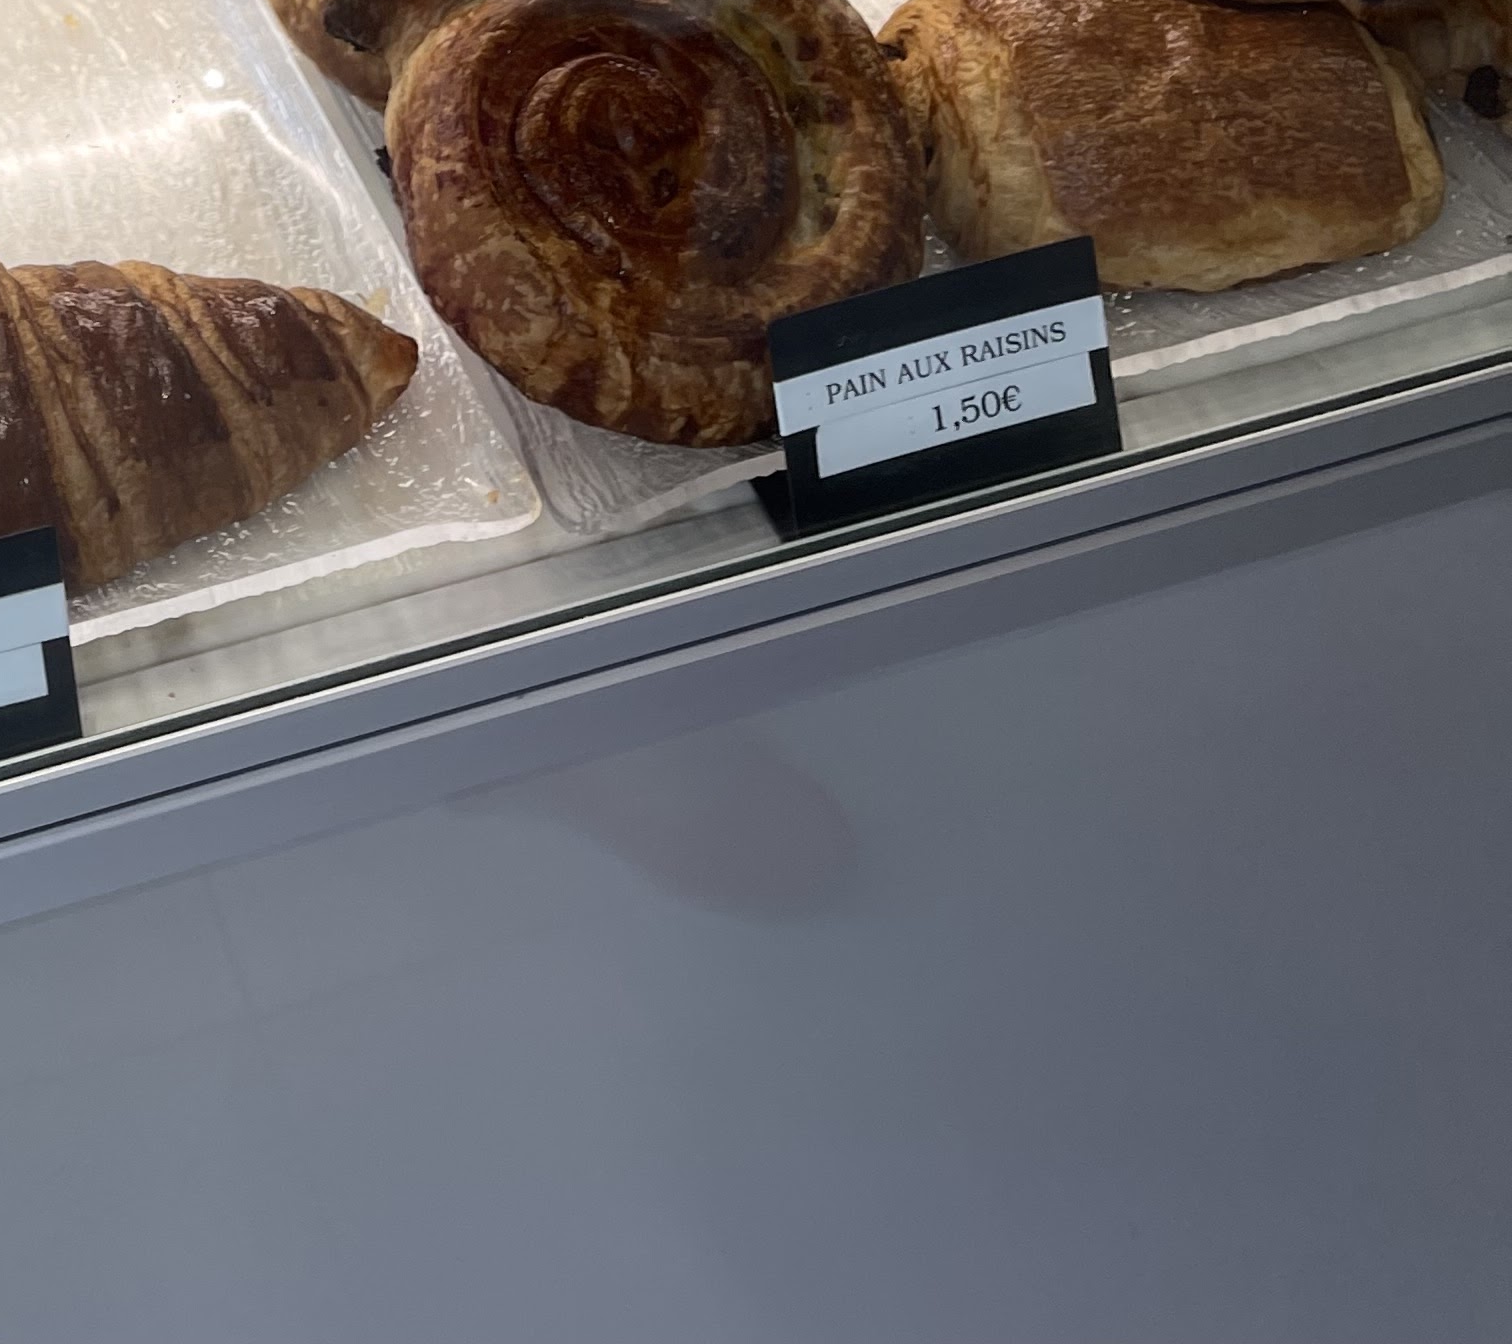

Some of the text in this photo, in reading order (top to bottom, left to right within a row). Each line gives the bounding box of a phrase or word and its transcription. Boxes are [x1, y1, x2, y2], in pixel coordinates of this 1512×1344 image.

[826, 321, 1067, 405] PAIN AUX RAISINS
[932, 385, 1023, 432] 1,50€
